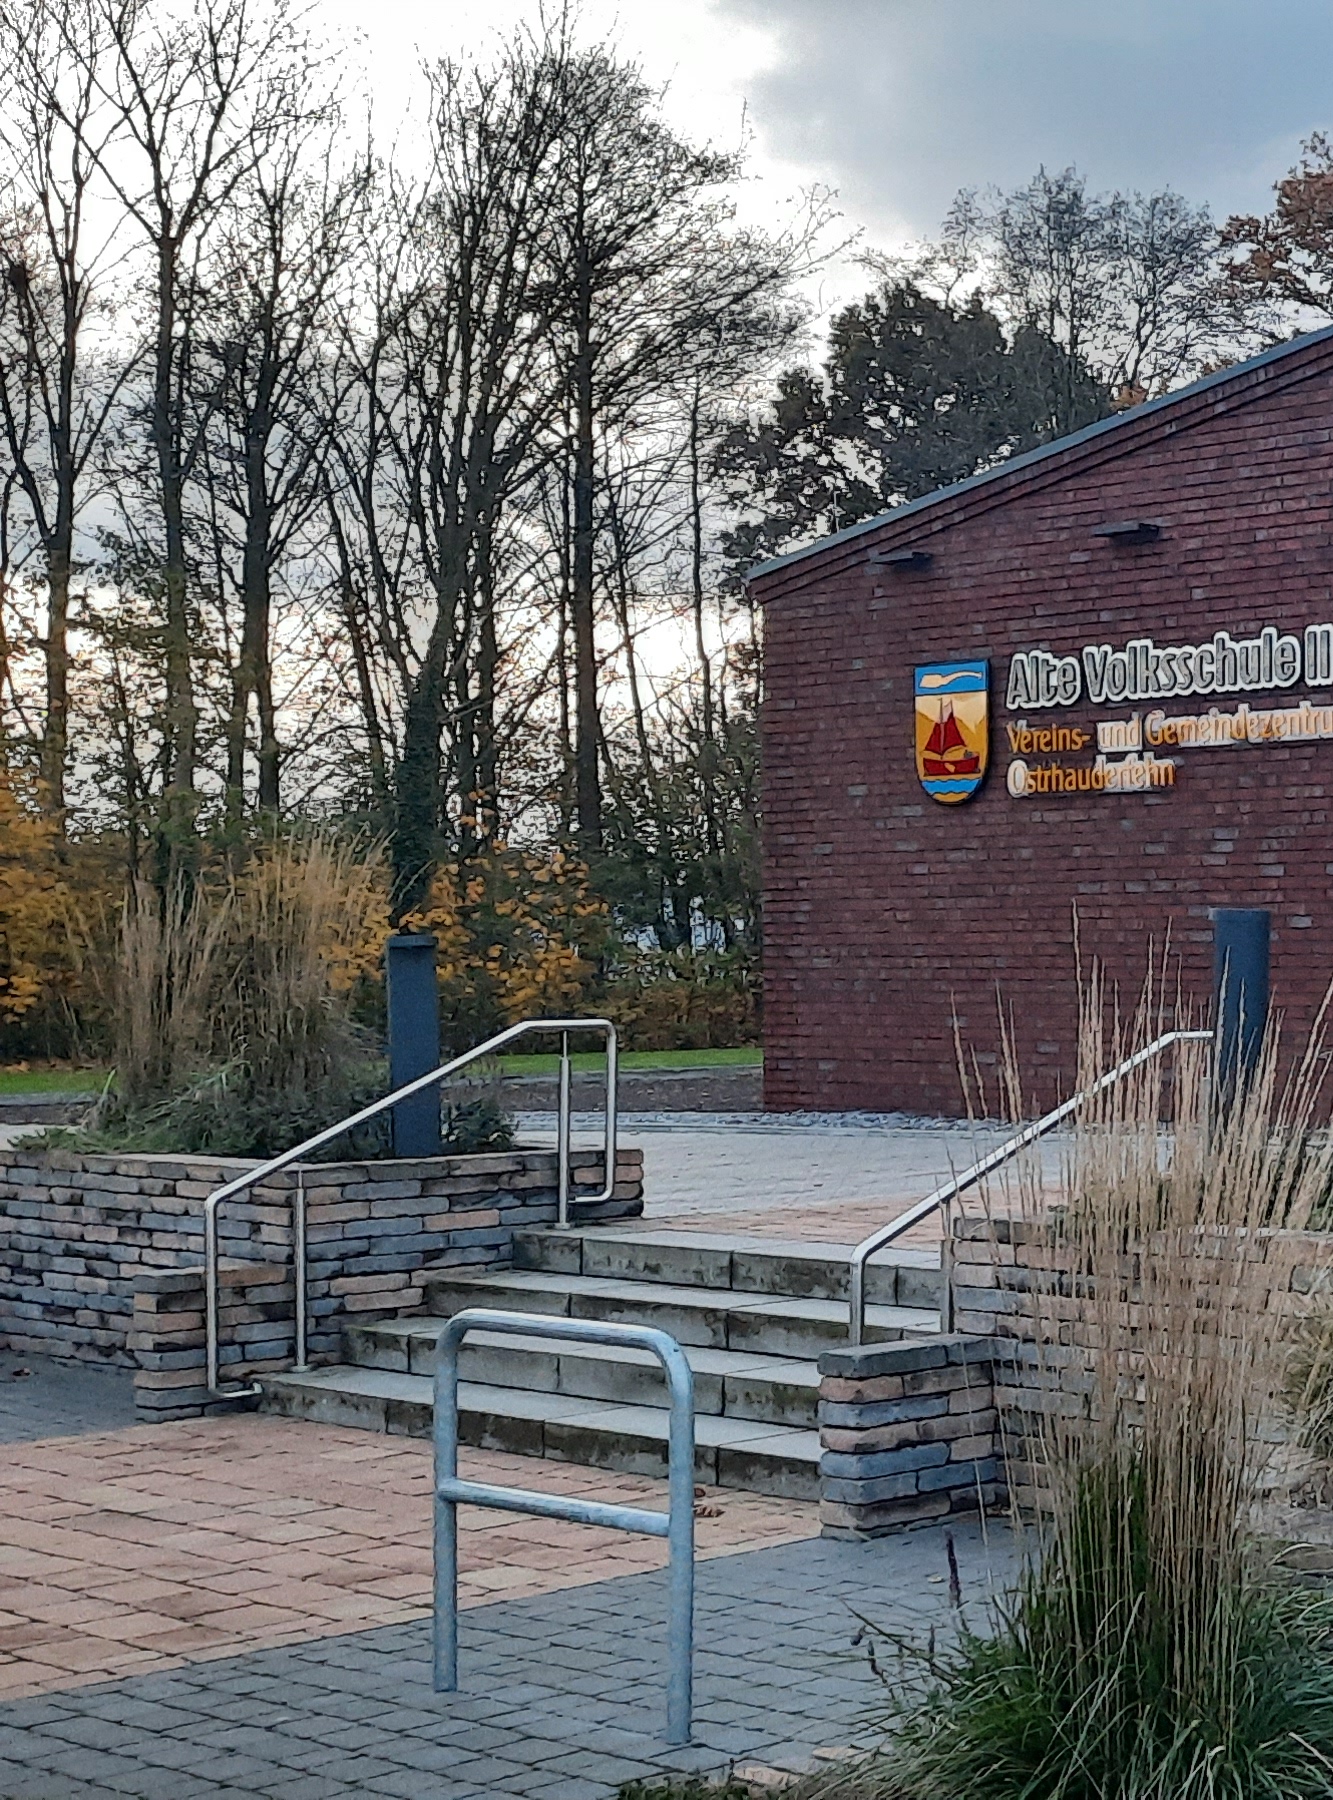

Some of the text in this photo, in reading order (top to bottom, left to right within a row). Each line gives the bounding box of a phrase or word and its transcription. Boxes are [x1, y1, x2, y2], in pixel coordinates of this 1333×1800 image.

[1008, 653, 1078, 706] Alte
[1084, 630, 1300, 698] Volksschule
[1007, 721, 1090, 754] Vereins-
[1099, 713, 1142, 751] und
[1009, 755, 1177, 796] Ostrhauderfehn
